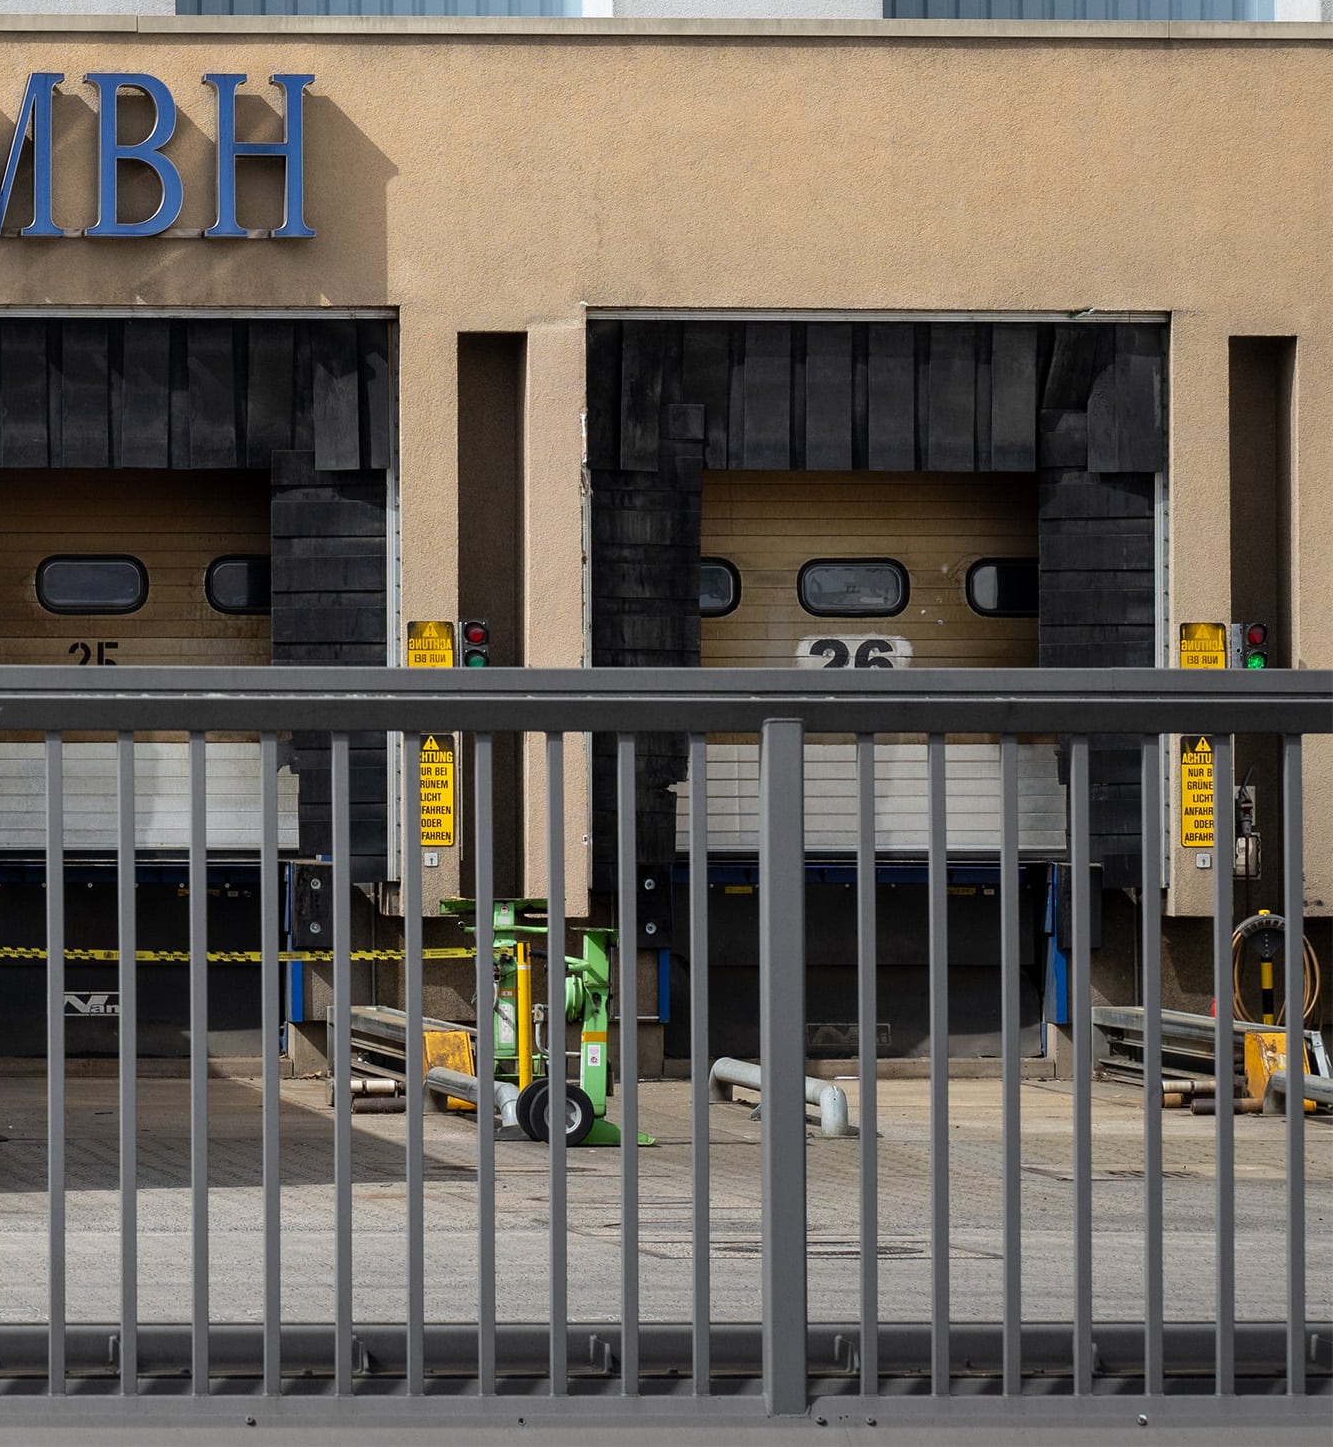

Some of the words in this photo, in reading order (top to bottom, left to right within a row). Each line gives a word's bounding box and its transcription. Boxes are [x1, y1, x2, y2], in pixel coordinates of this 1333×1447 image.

[810, 639, 893, 668] 26
[421, 751, 453, 763] HTUNG
[1182, 752, 1212, 764] ACHTU
[421, 767, 432, 776] UR
[435, 767, 447, 776] BEI
[1188, 768, 1204, 777] NUR
[420, 778, 448, 789] RÜNEM
[1187, 779, 1213, 790] GRÜNE
[421, 805, 451, 815] FAHREN
[1184, 807, 1213, 816] ANFAHR
[421, 818, 442, 827] ODER
[421, 831, 451, 840] FAHREN
[1184, 832, 1214, 842] ABFAHR
